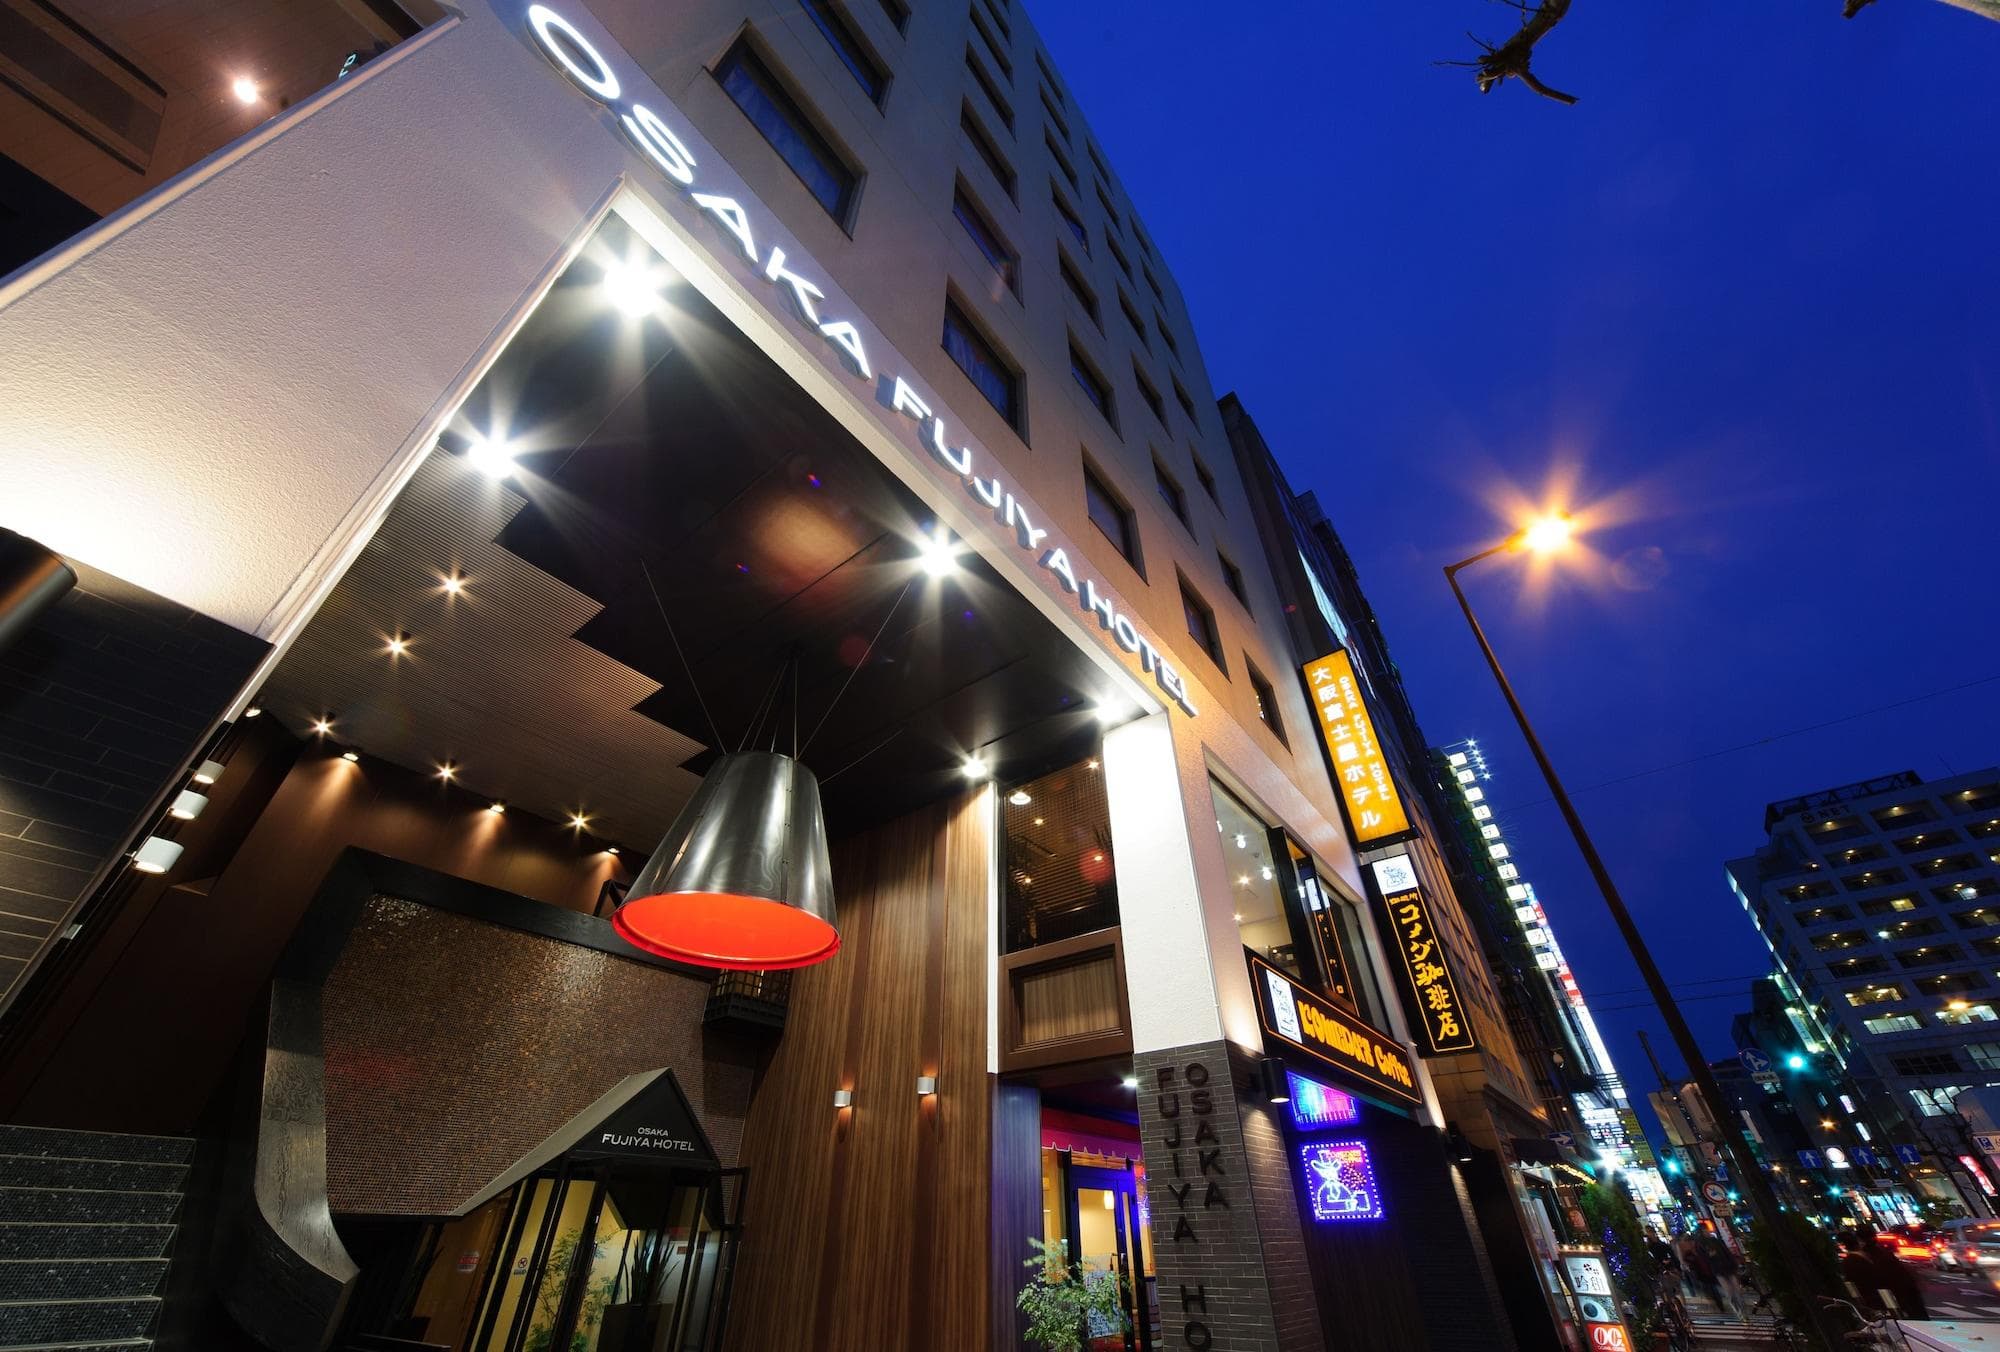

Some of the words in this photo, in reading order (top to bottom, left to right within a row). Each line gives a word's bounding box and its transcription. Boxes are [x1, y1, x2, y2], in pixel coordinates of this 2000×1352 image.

[528, 4, 872, 380] OSAKA
[891, 376, 1078, 593] FUJIYA
[1086, 579, 1198, 718] HOTEL
[1399, 904, 1460, 1041] コメダ珈琲店
[601, 1133, 650, 1148] FUJIYA
[652, 1138, 695, 1152] HOTEL
[637, 1127, 669, 1137] OSAKA
[1156, 1067, 1199, 1243] FUJIYA
[1185, 1062, 1230, 1209] OSAKA
